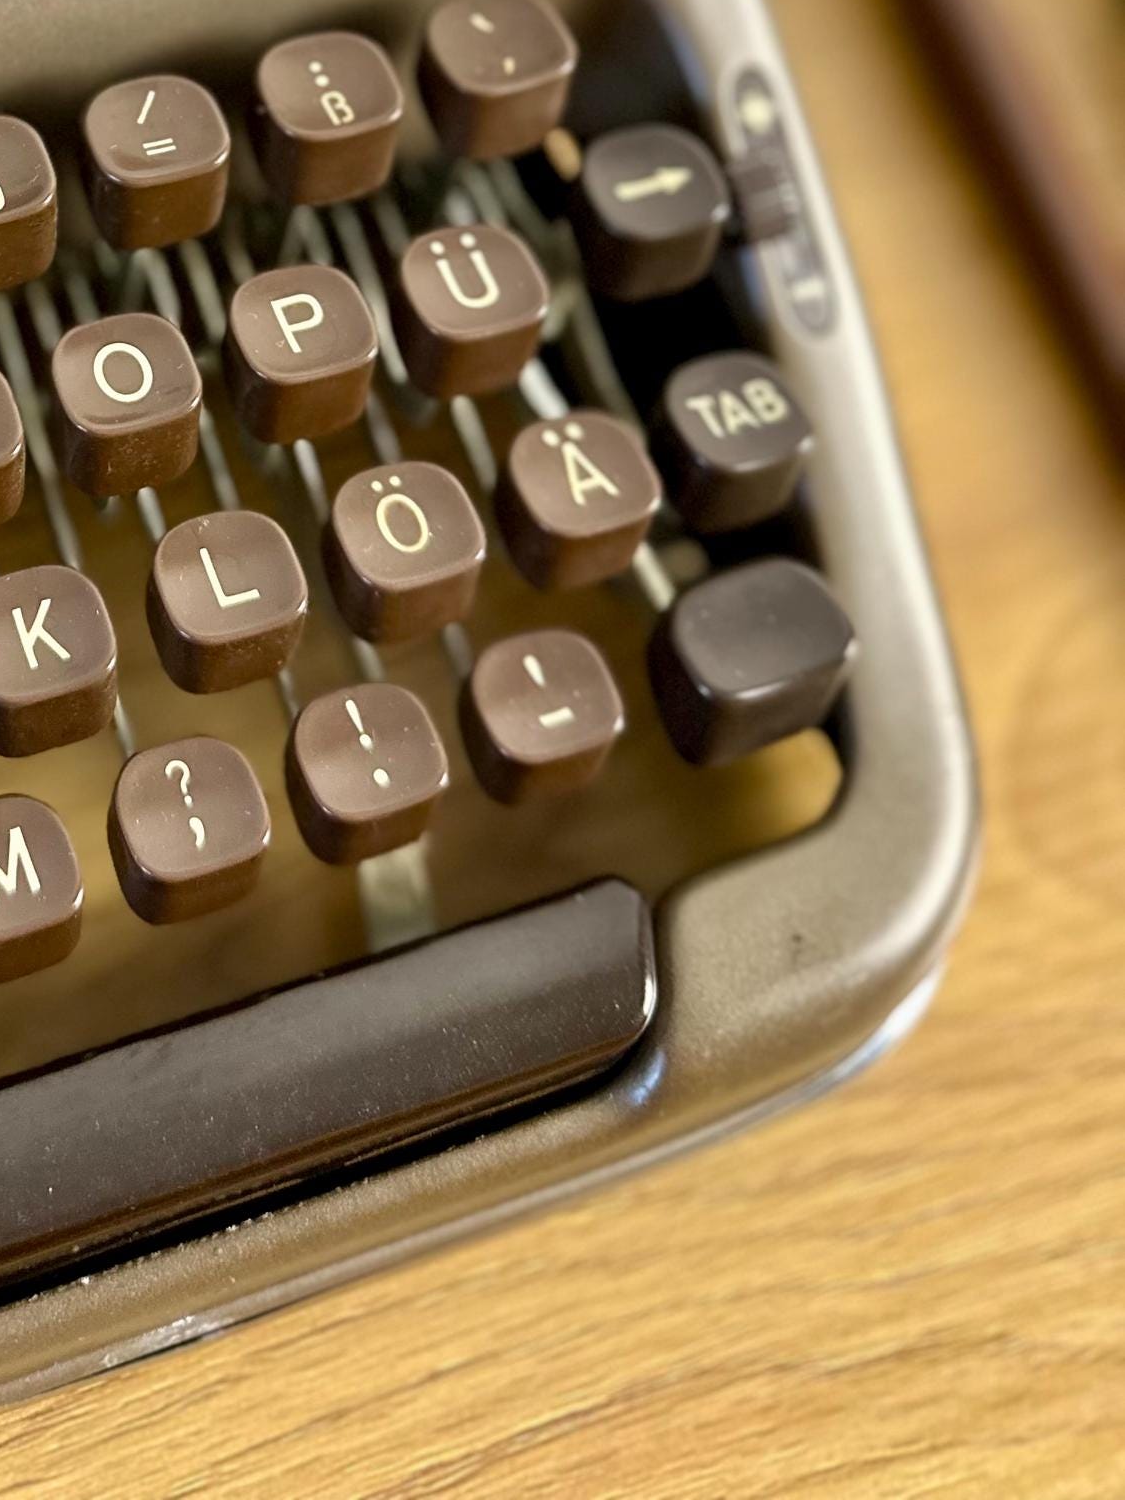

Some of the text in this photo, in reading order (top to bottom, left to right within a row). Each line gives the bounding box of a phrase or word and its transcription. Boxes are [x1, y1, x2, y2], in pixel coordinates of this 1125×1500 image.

[309, 61, 330, 87] :
[136, 90, 156, 125] /
[142, 137, 177, 156] =
[430, 233, 500, 309] Ü
[270, 293, 324, 354] P
[93, 342, 154, 403] O
[685, 379, 788, 439] TAB
[542, 423, 619, 506] Ä
[371, 475, 433, 554] Ö
[199, 547, 261, 608] L
[11, 598, 71, 670] K
[345, 699, 373, 750] !
[164, 758, 193, 808] ?
[373, 768, 390, 787] .
